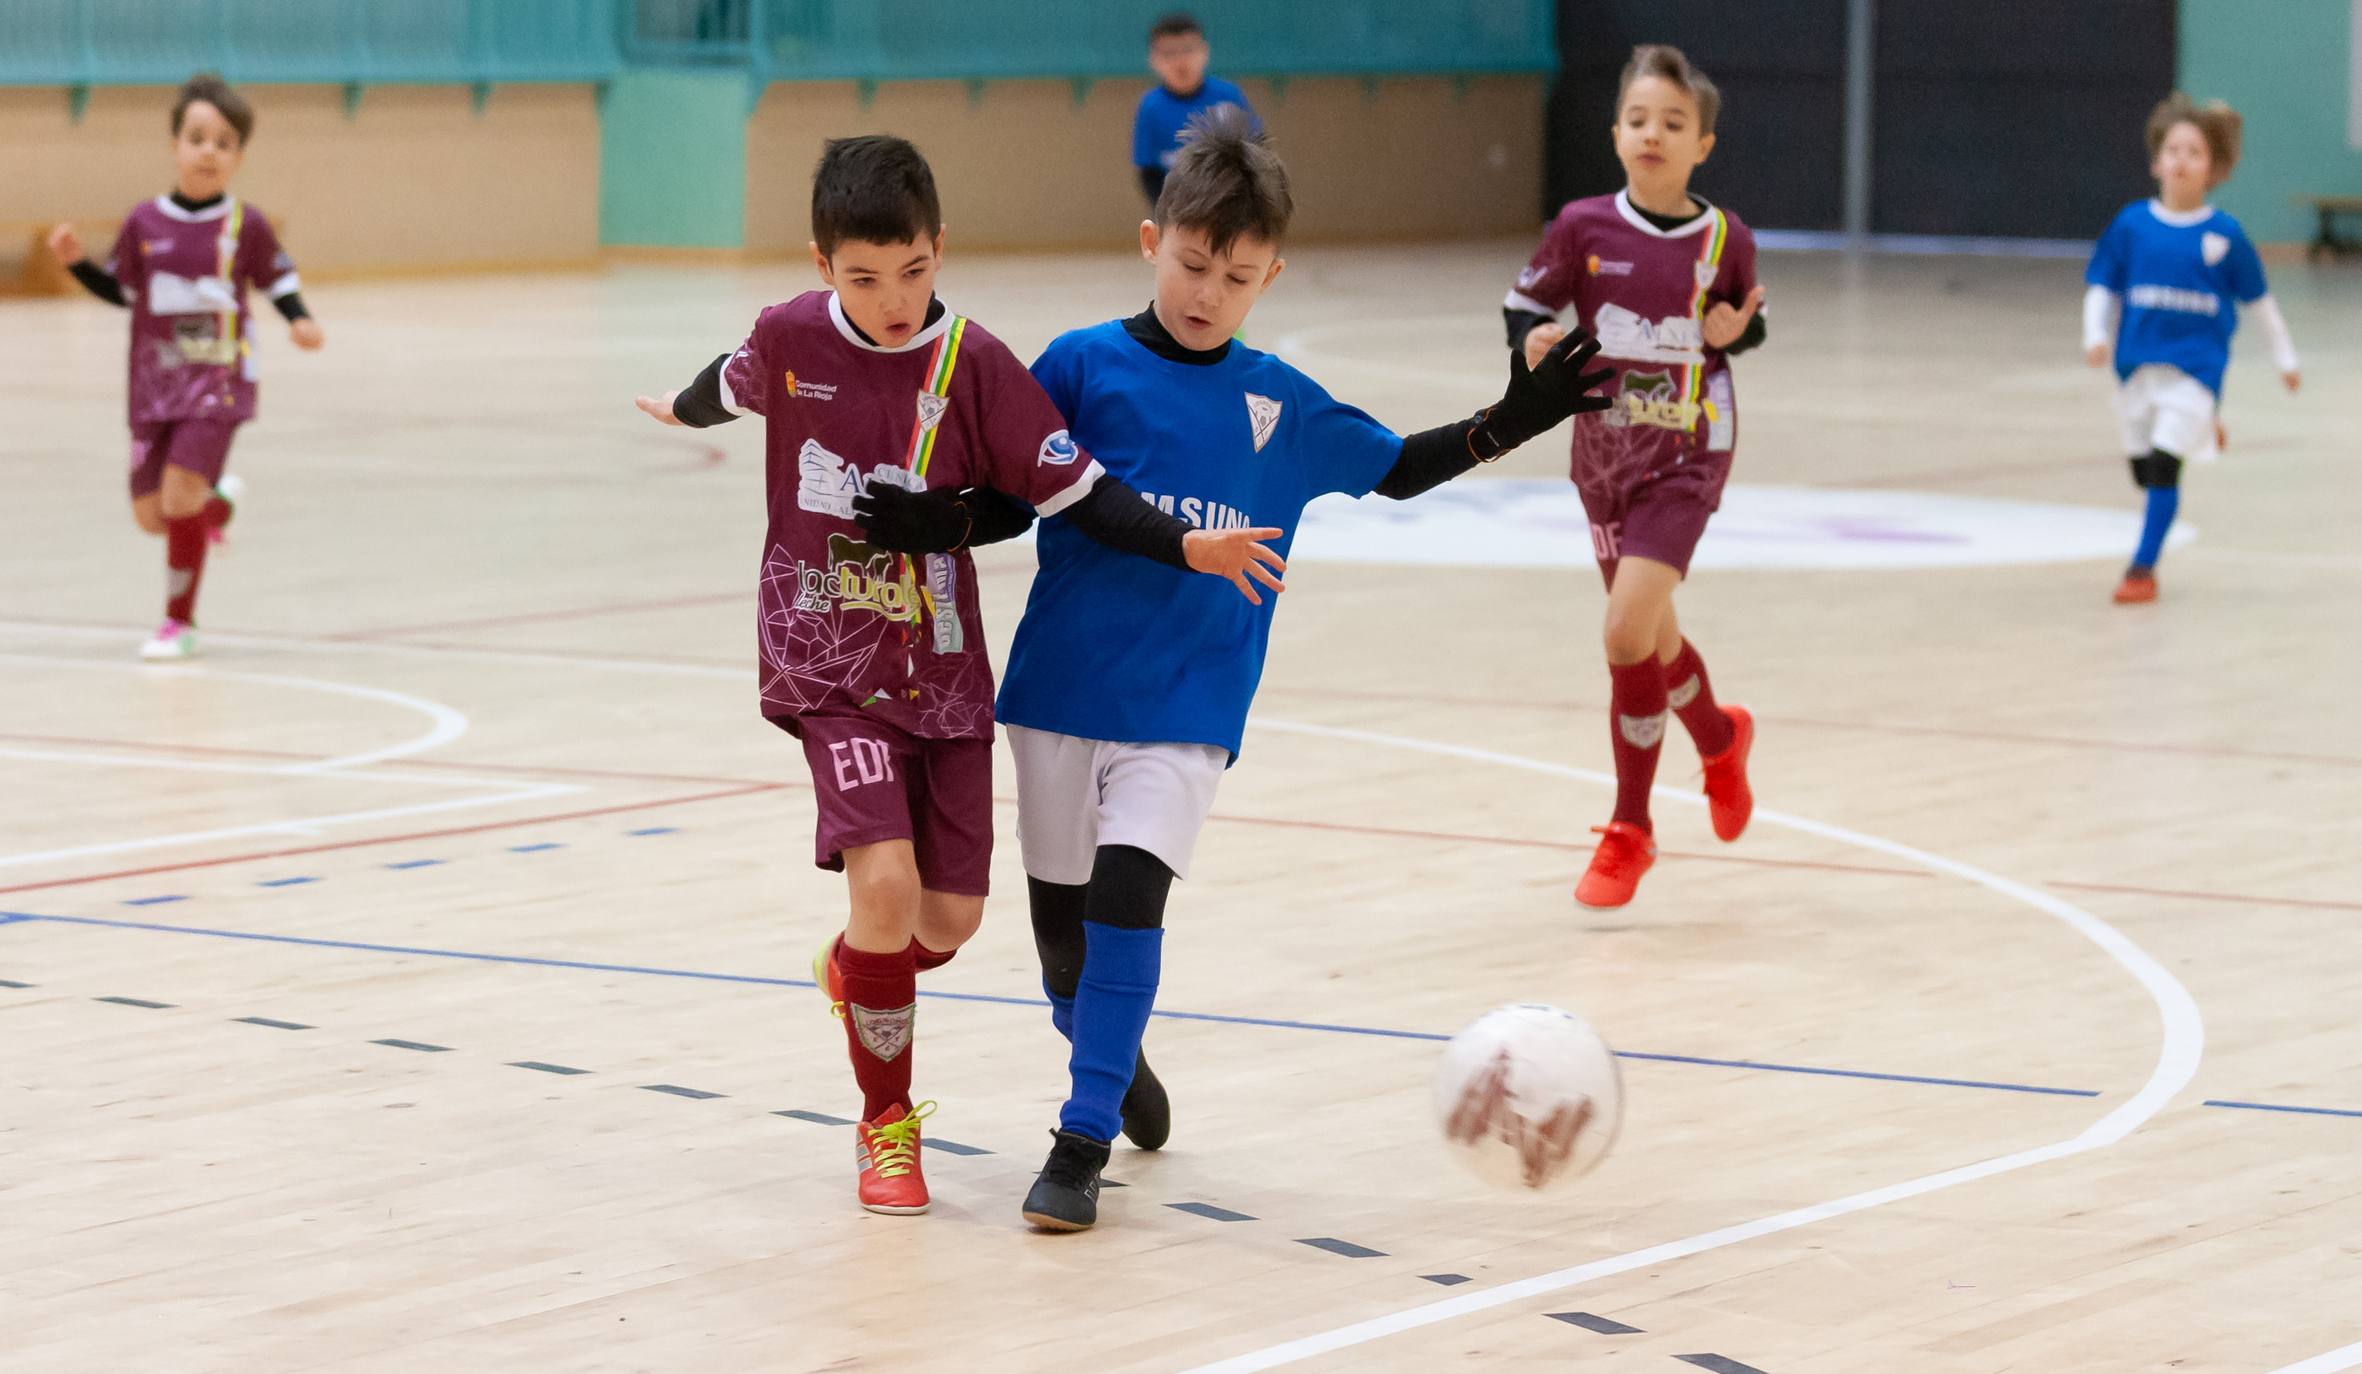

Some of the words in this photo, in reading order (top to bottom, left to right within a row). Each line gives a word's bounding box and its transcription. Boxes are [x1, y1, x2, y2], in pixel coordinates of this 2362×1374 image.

[796, 380, 837, 392] Comunidad
[803, 389, 813, 397] La
[814, 391, 833, 401] Rioja
[1592, 521, 1622, 560] DF
[795, 592, 831, 613] leche
